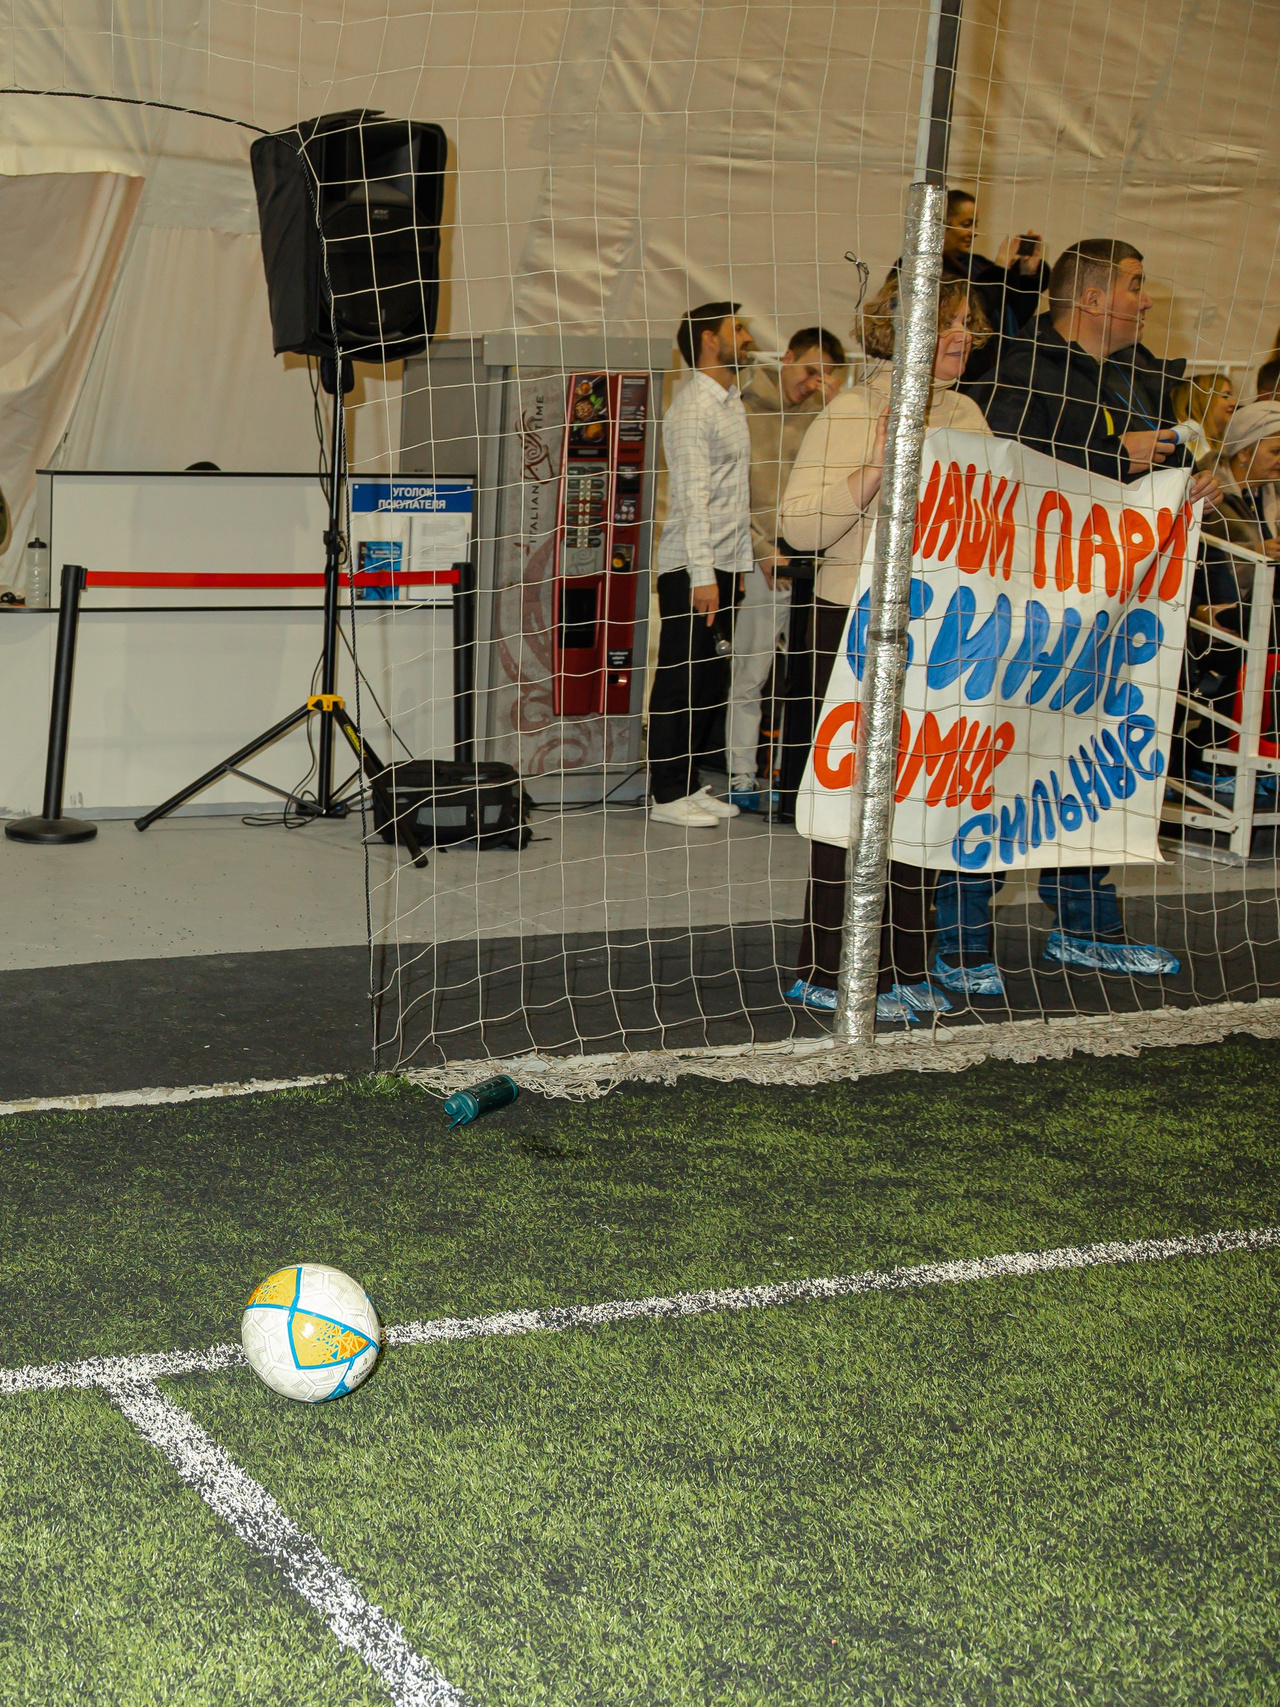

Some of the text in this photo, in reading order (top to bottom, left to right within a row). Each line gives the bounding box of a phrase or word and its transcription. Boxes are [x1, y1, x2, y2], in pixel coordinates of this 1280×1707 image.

[529, 395, 545, 543] ITALIAN TIME
[392, 486, 434, 498] УГОЛОК
[378, 499, 446, 510] ПОКУПАТЕЛЯ
